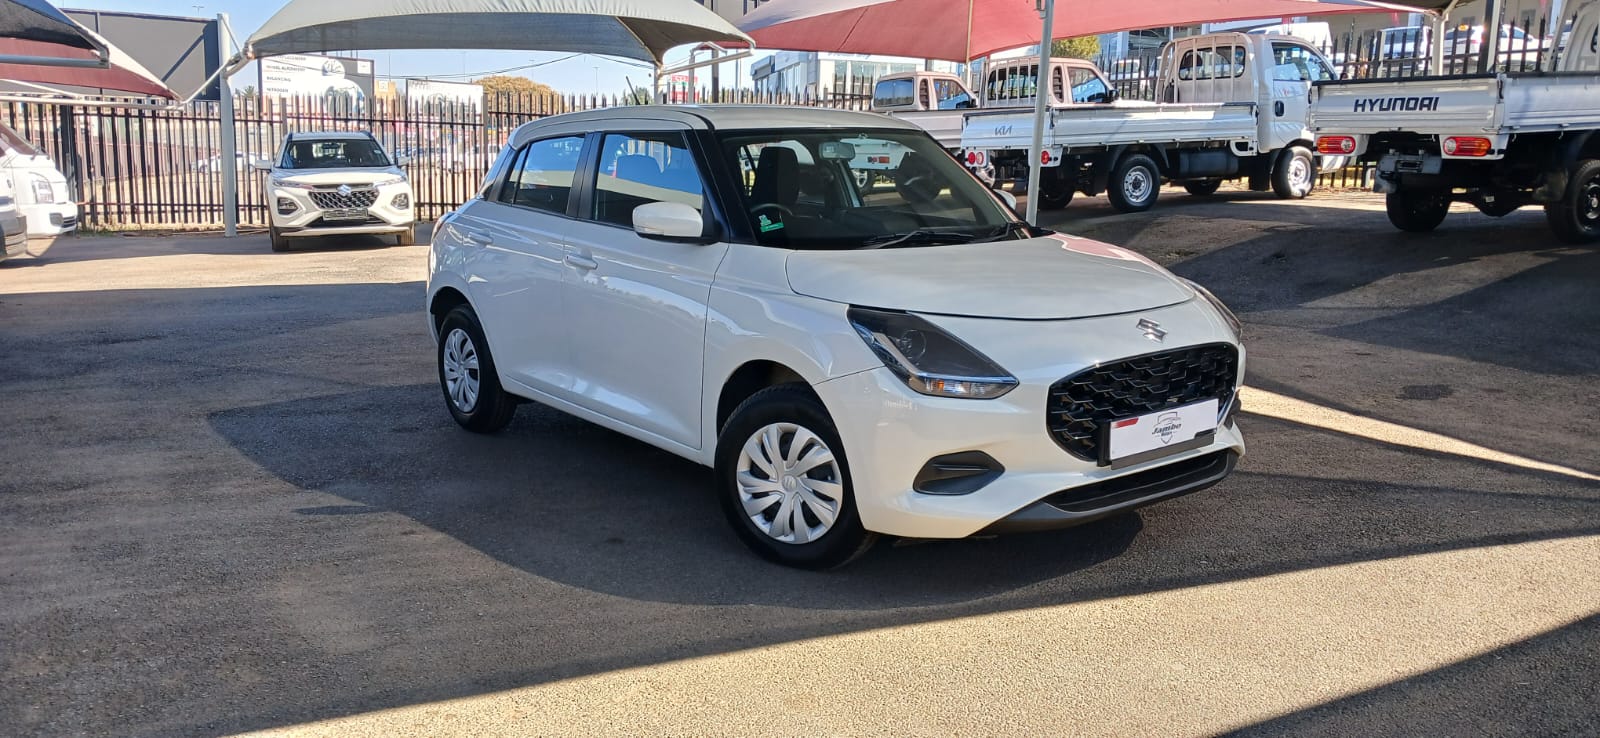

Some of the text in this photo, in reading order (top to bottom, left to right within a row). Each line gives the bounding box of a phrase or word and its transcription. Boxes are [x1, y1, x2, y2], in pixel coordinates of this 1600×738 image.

[1353, 96, 1440, 112] HYUNDAI
[994, 125, 1013, 136] KIA
[1151, 423, 1182, 434] Jambo
